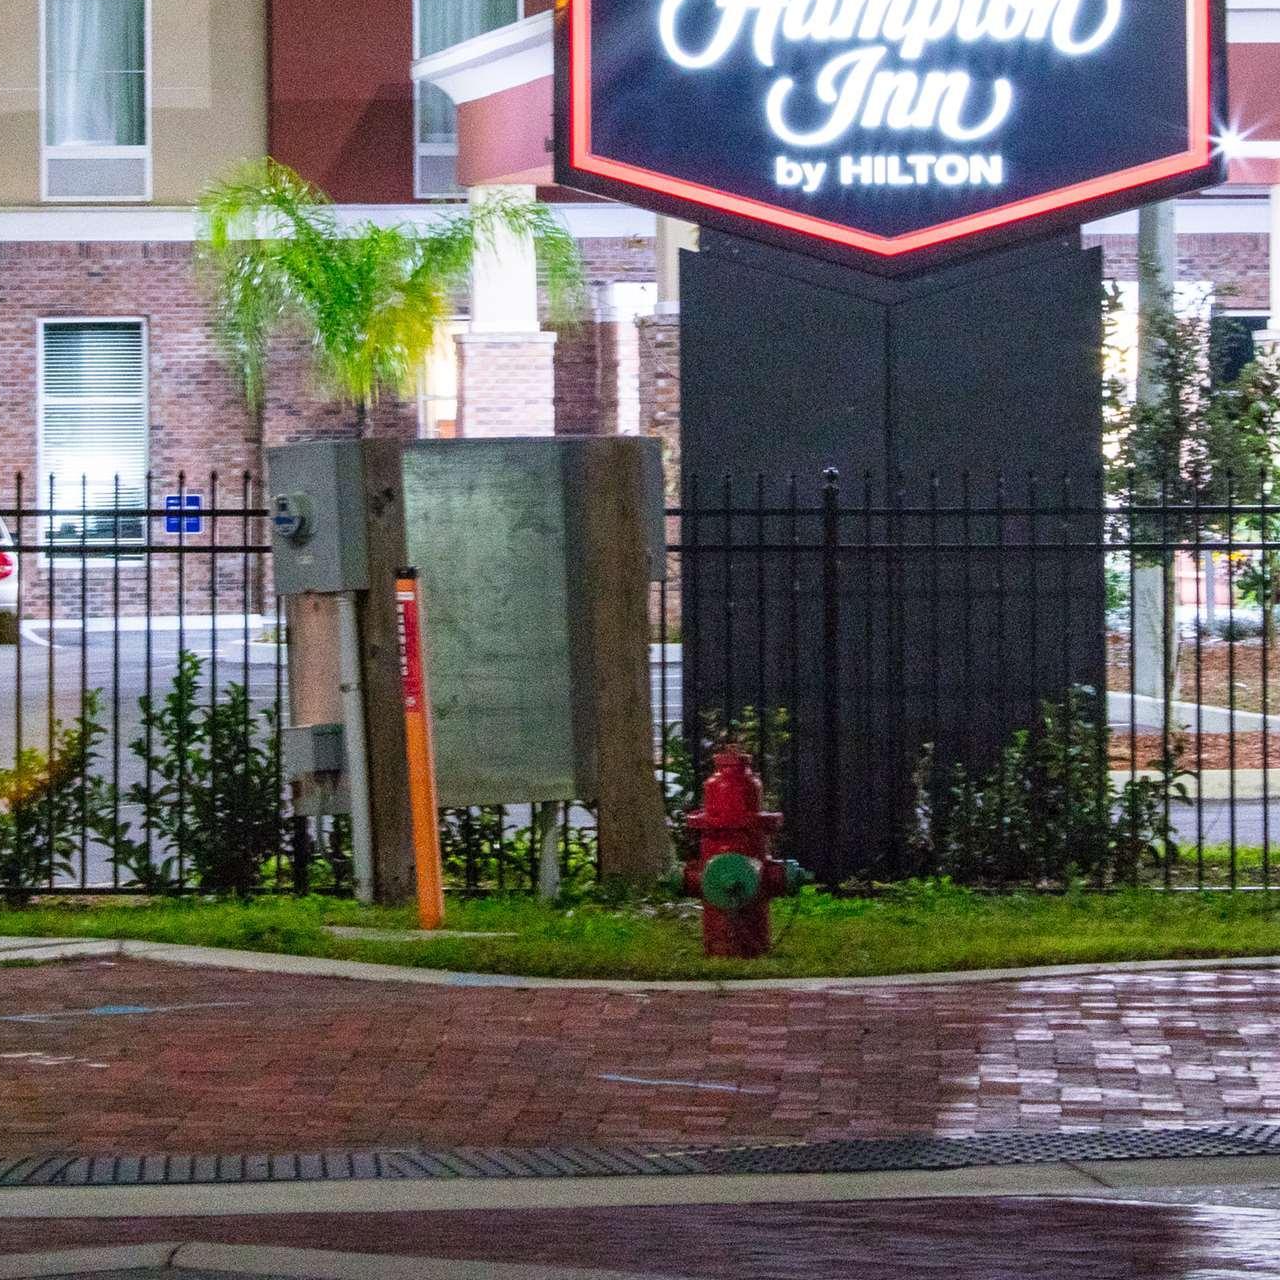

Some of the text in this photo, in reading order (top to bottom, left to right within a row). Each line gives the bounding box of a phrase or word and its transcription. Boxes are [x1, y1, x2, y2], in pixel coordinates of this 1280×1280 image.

[766, 46, 1013, 147] Inn
[775, 154, 1002, 192] by HILTON
